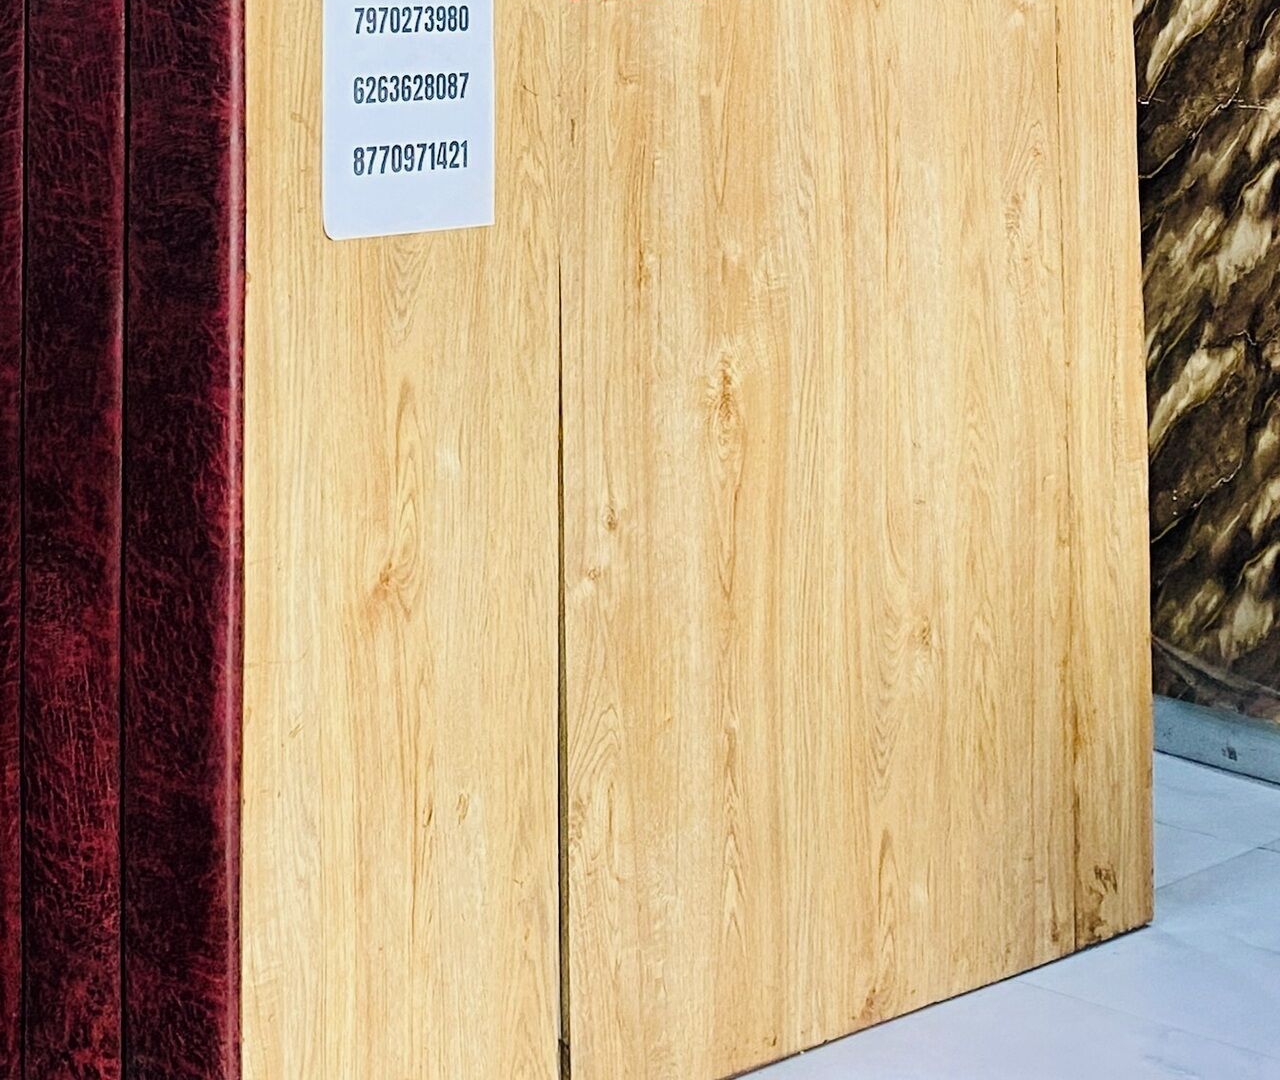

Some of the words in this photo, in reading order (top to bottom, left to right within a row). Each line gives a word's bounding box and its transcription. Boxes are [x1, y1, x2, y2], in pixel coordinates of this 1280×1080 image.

[355, 6, 468, 34] 7970273980
[354, 73, 469, 104] 6263628087
[354, 141, 467, 175] 8770971421
